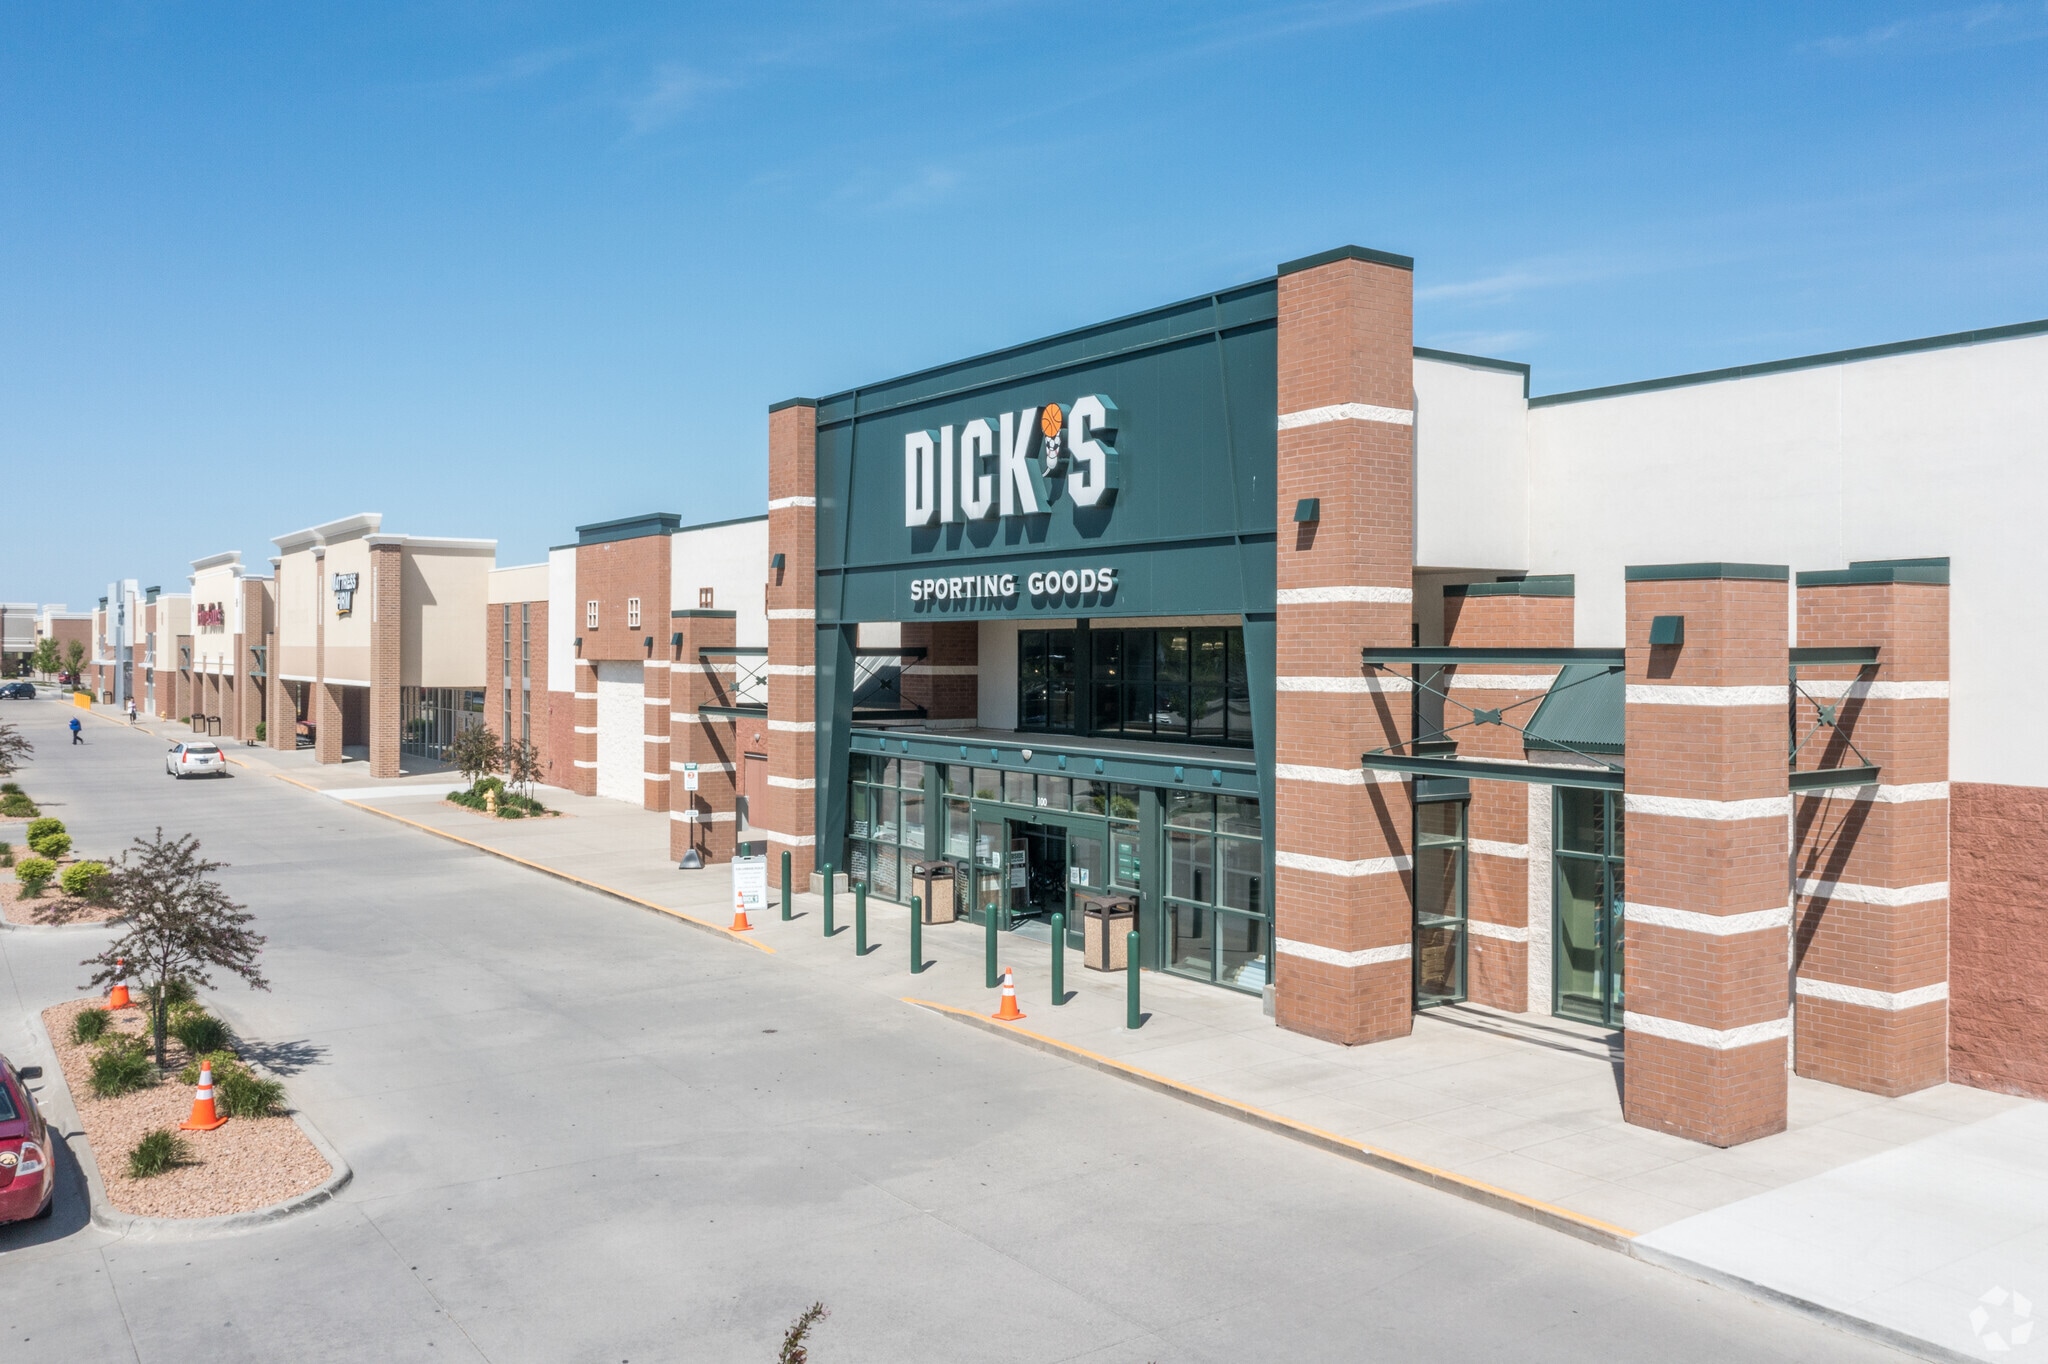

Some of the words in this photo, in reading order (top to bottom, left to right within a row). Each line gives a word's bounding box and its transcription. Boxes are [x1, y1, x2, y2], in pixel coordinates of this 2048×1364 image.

[905, 394, 1107, 527] DICK'S
[910, 574, 1015, 600] SPORTING
[1028, 568, 1113, 595] GOODS
[1037, 797, 1048, 807] 100
